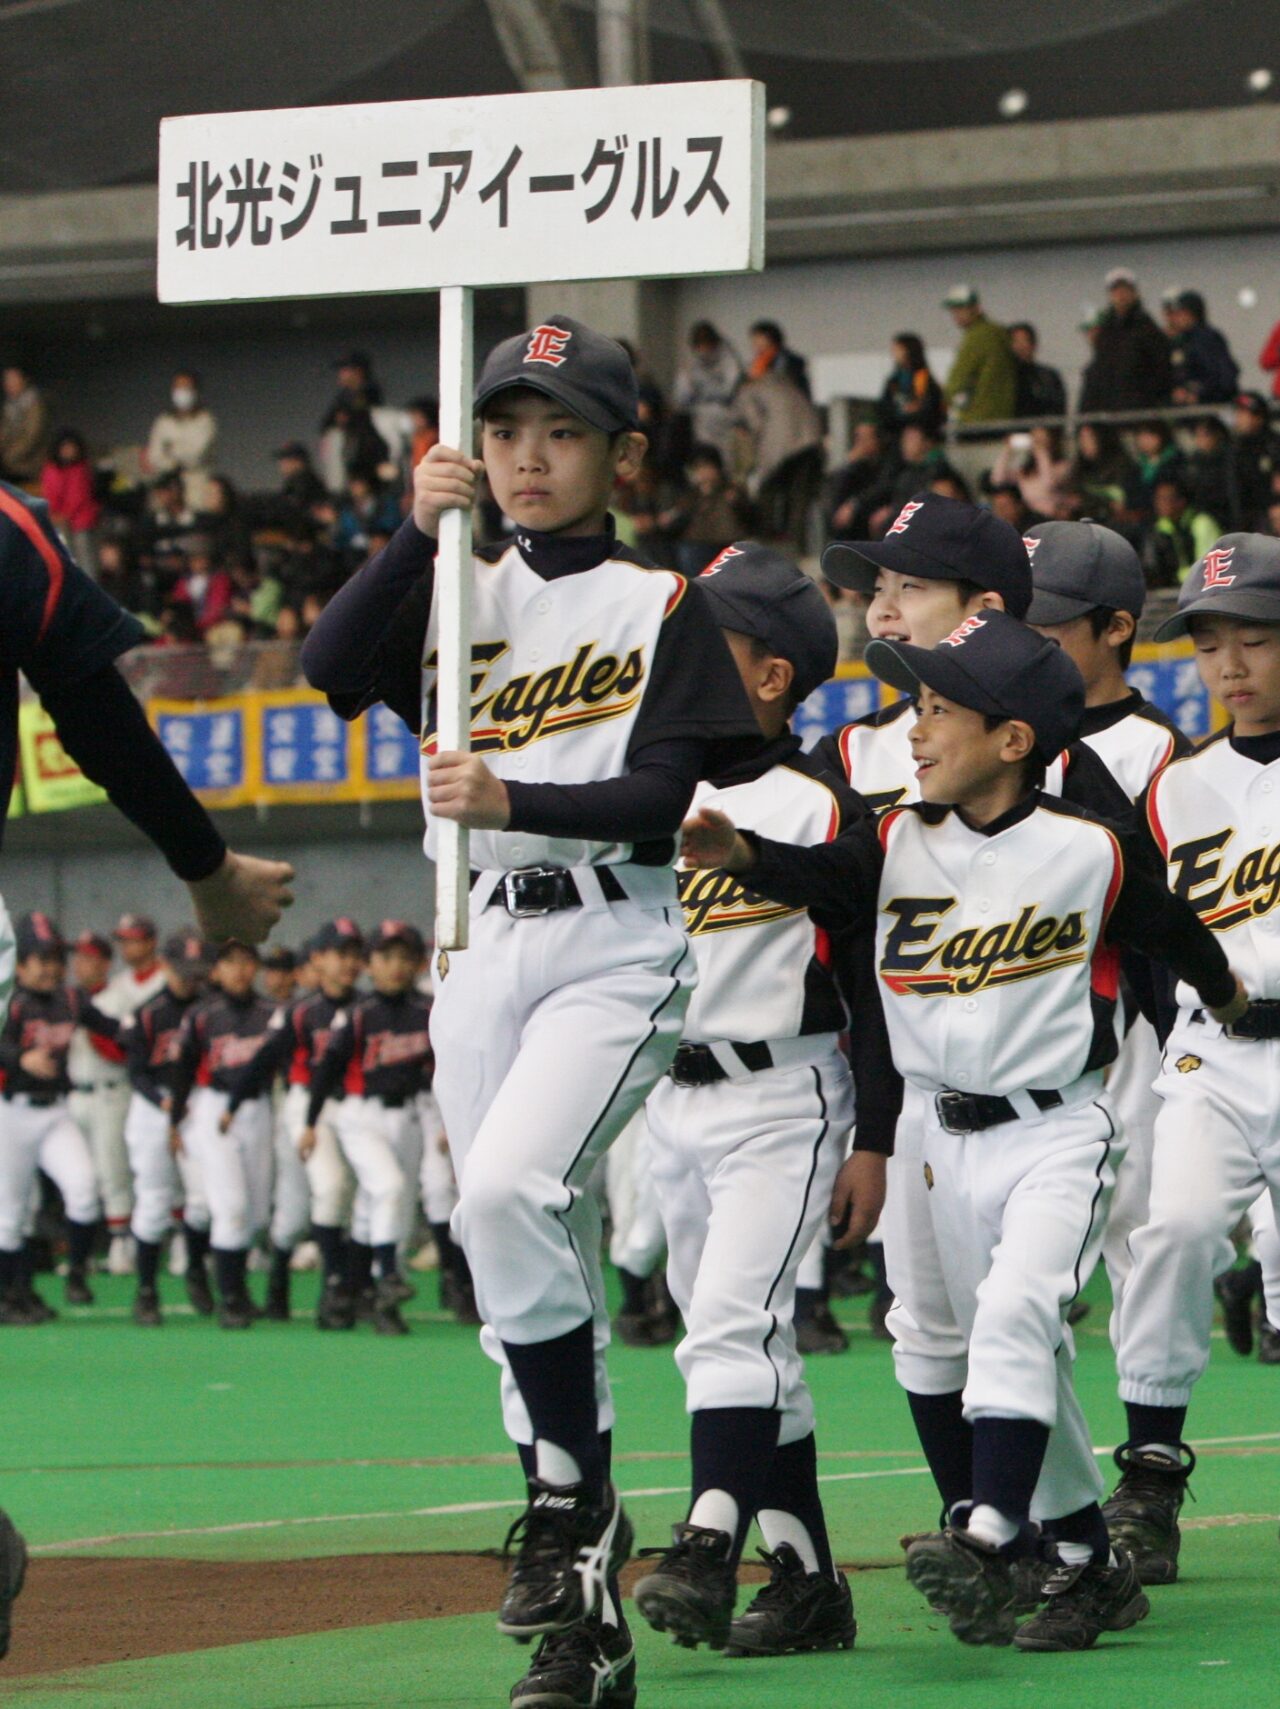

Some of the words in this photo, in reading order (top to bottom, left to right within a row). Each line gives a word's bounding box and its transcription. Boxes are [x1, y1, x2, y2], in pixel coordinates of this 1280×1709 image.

[175, 134, 730, 251] 北光ジュニアイーグルス
[523, 325, 571, 367] E
[1201, 547, 1236, 592] E
[421, 639, 646, 751] Eagles
[879, 897, 1088, 996] Eagles
